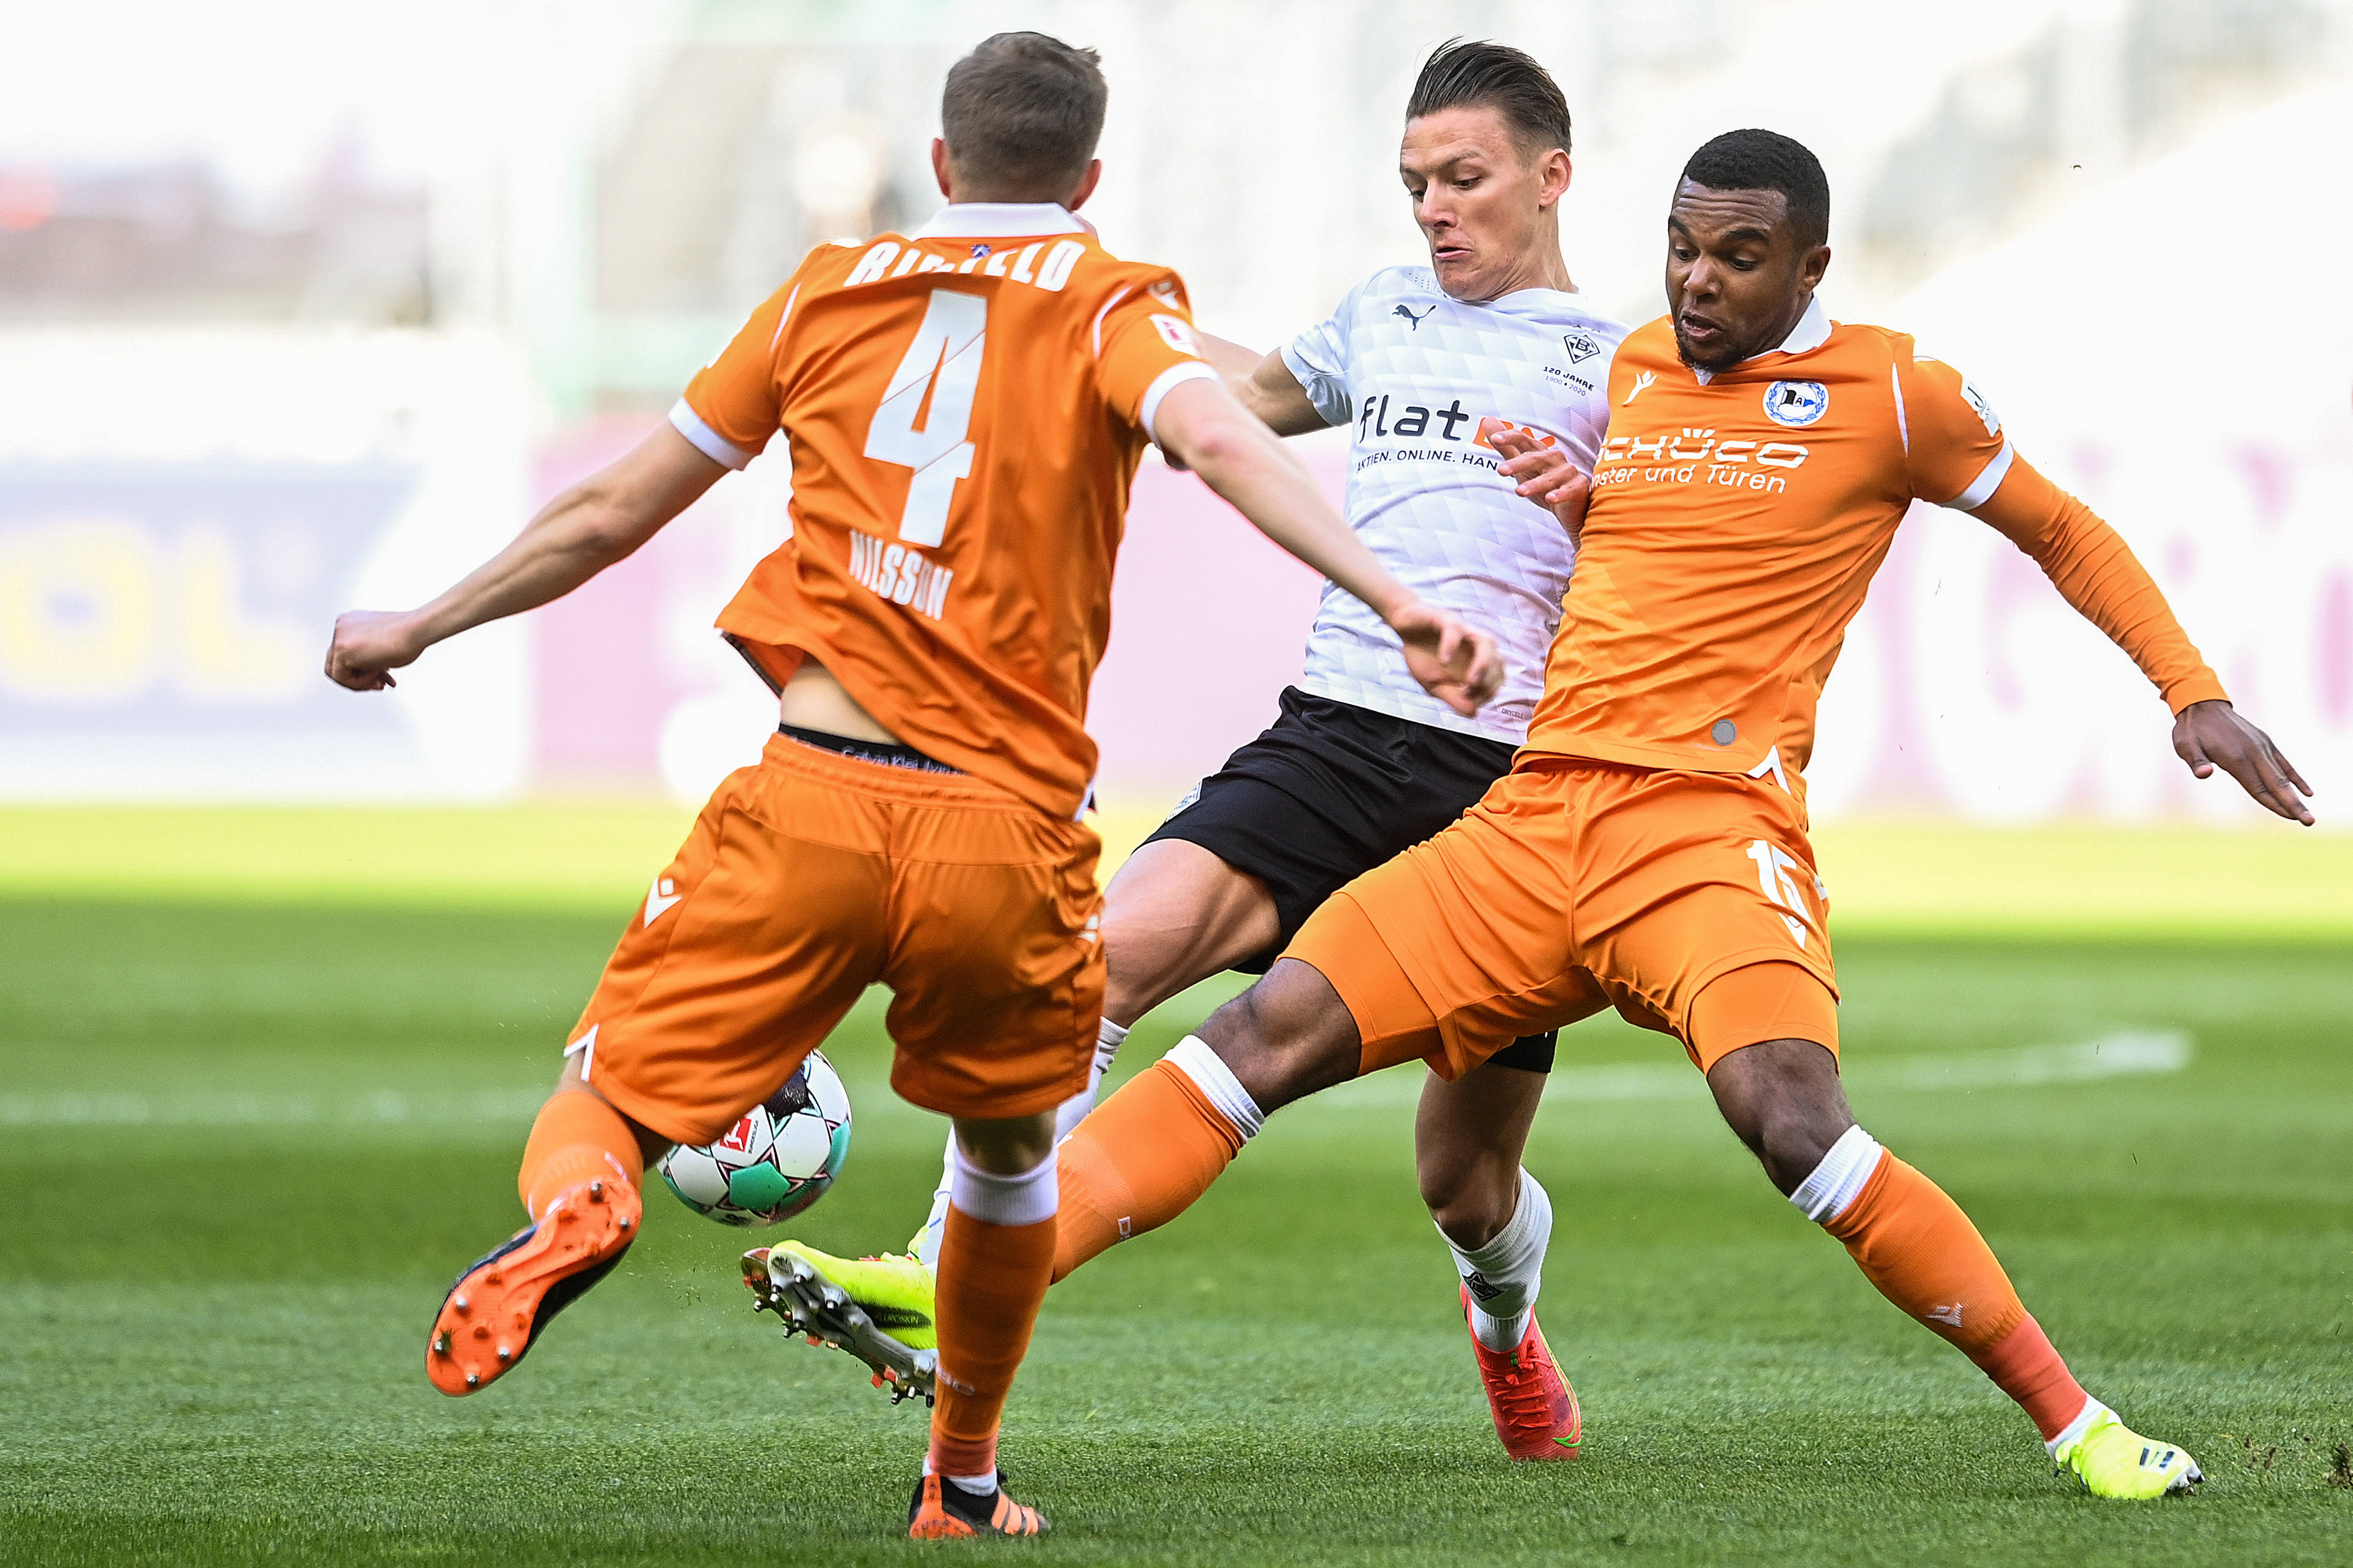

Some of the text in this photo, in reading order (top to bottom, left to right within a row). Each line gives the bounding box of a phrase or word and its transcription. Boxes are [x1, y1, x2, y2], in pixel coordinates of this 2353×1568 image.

[1543, 366, 1594, 391] 120 JAHRE
[1545, 375, 1586, 396] 1900 2020
[863, 288, 987, 548] 4
[1356, 449, 1498, 473] AKTIEN. ONLINE. HAN
[1590, 464, 1786, 493] nster und Türen
[849, 529, 954, 621] NILSSON
